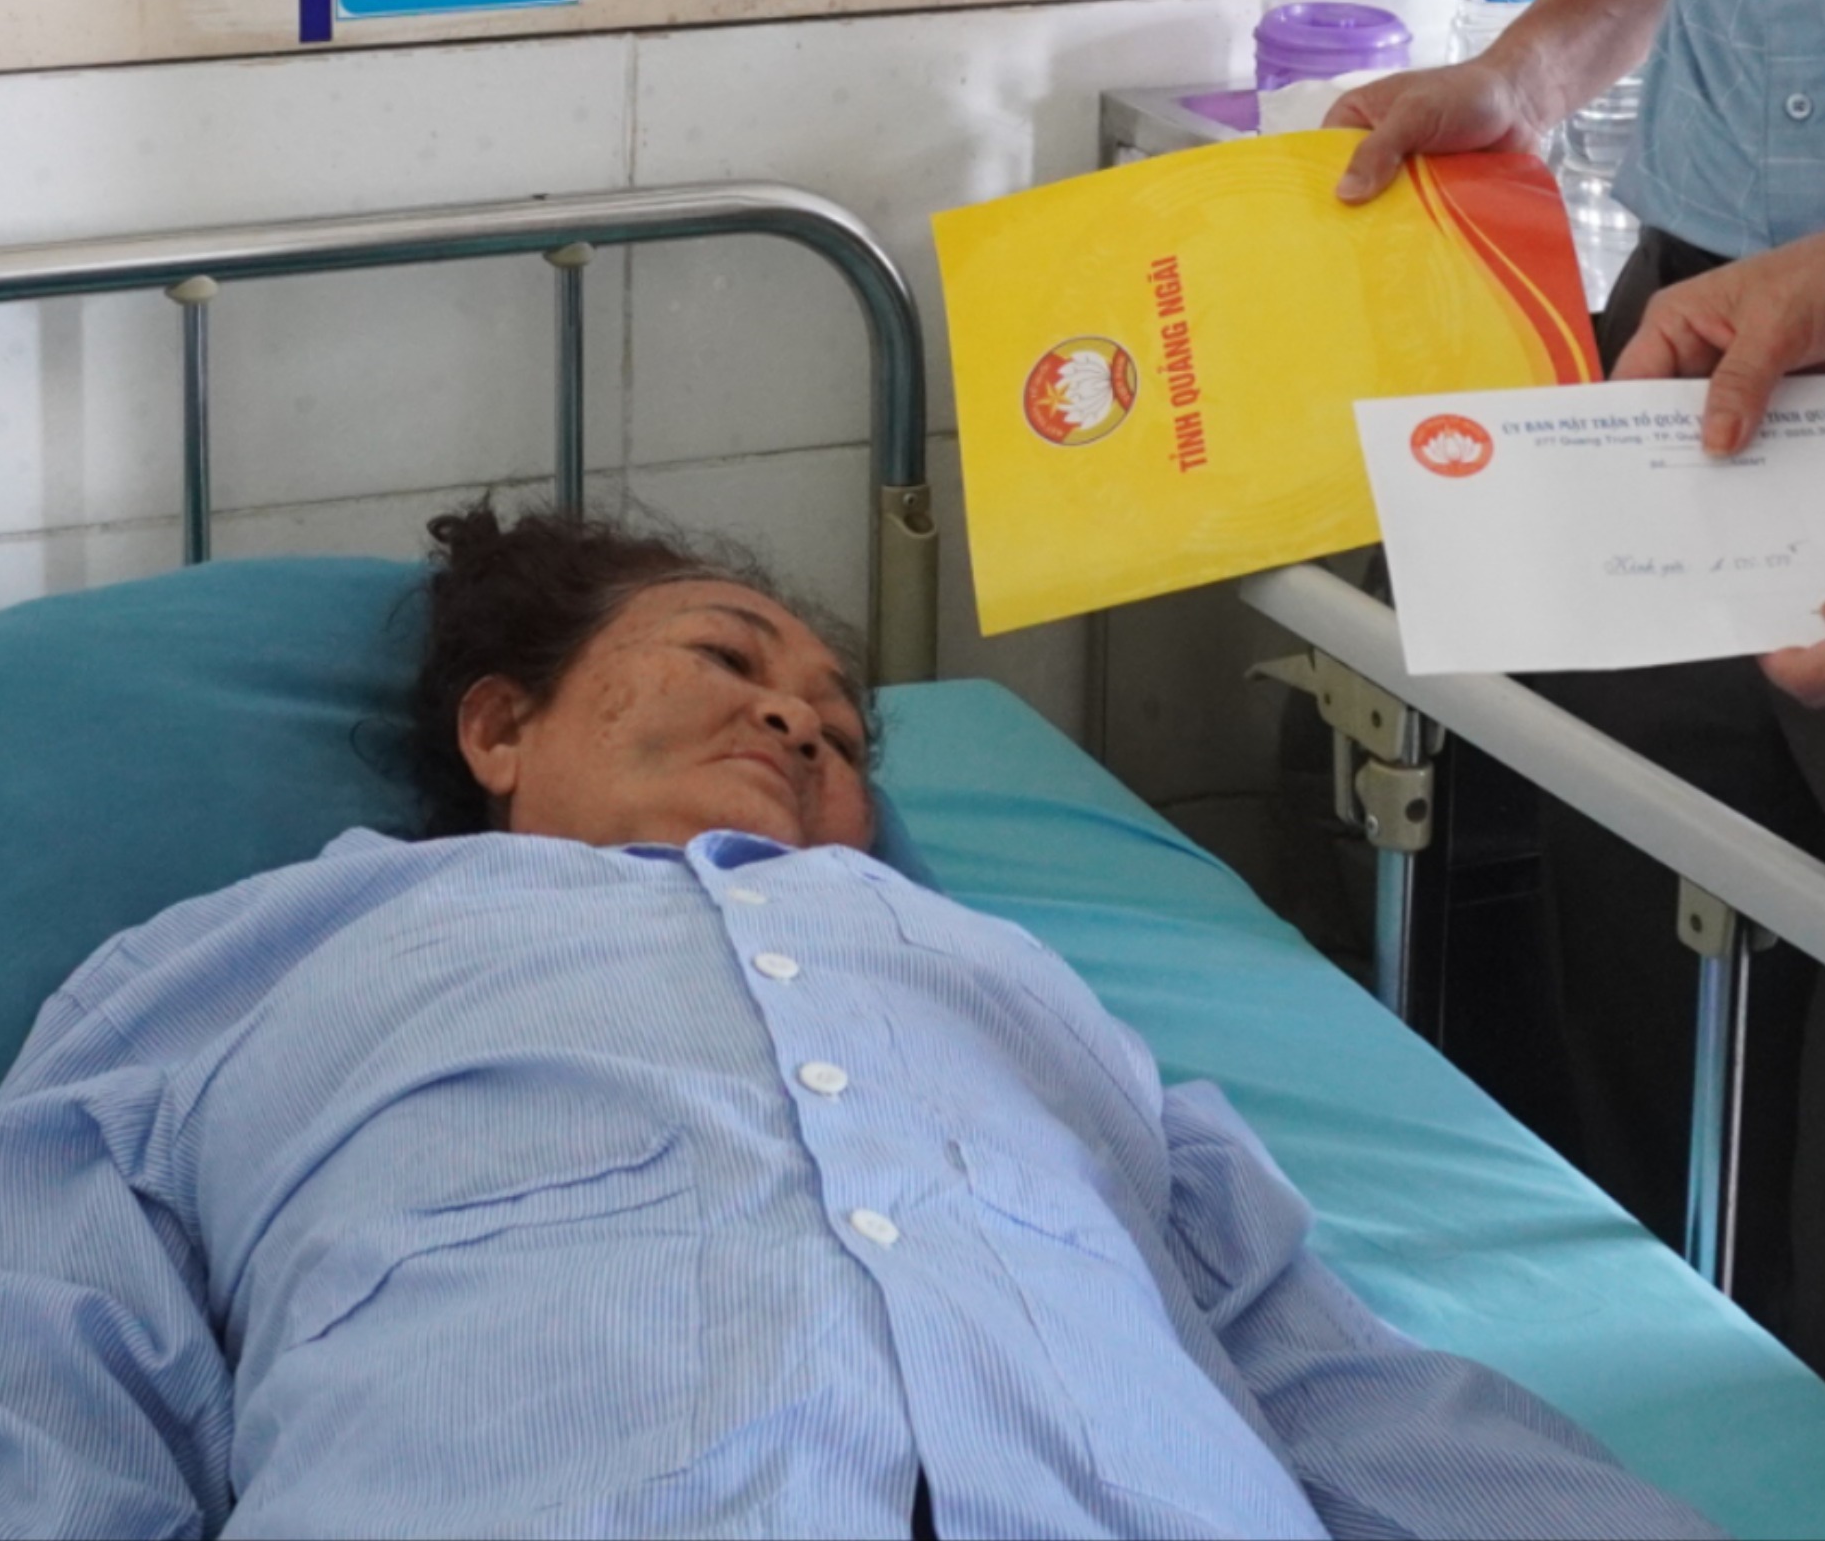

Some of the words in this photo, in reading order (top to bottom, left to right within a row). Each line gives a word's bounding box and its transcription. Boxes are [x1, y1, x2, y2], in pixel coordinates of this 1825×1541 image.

[1147, 255, 1185, 318] NGÃI
[1157, 321, 1201, 408] QUẢNG
[1168, 412, 1208, 473] TỈNH
